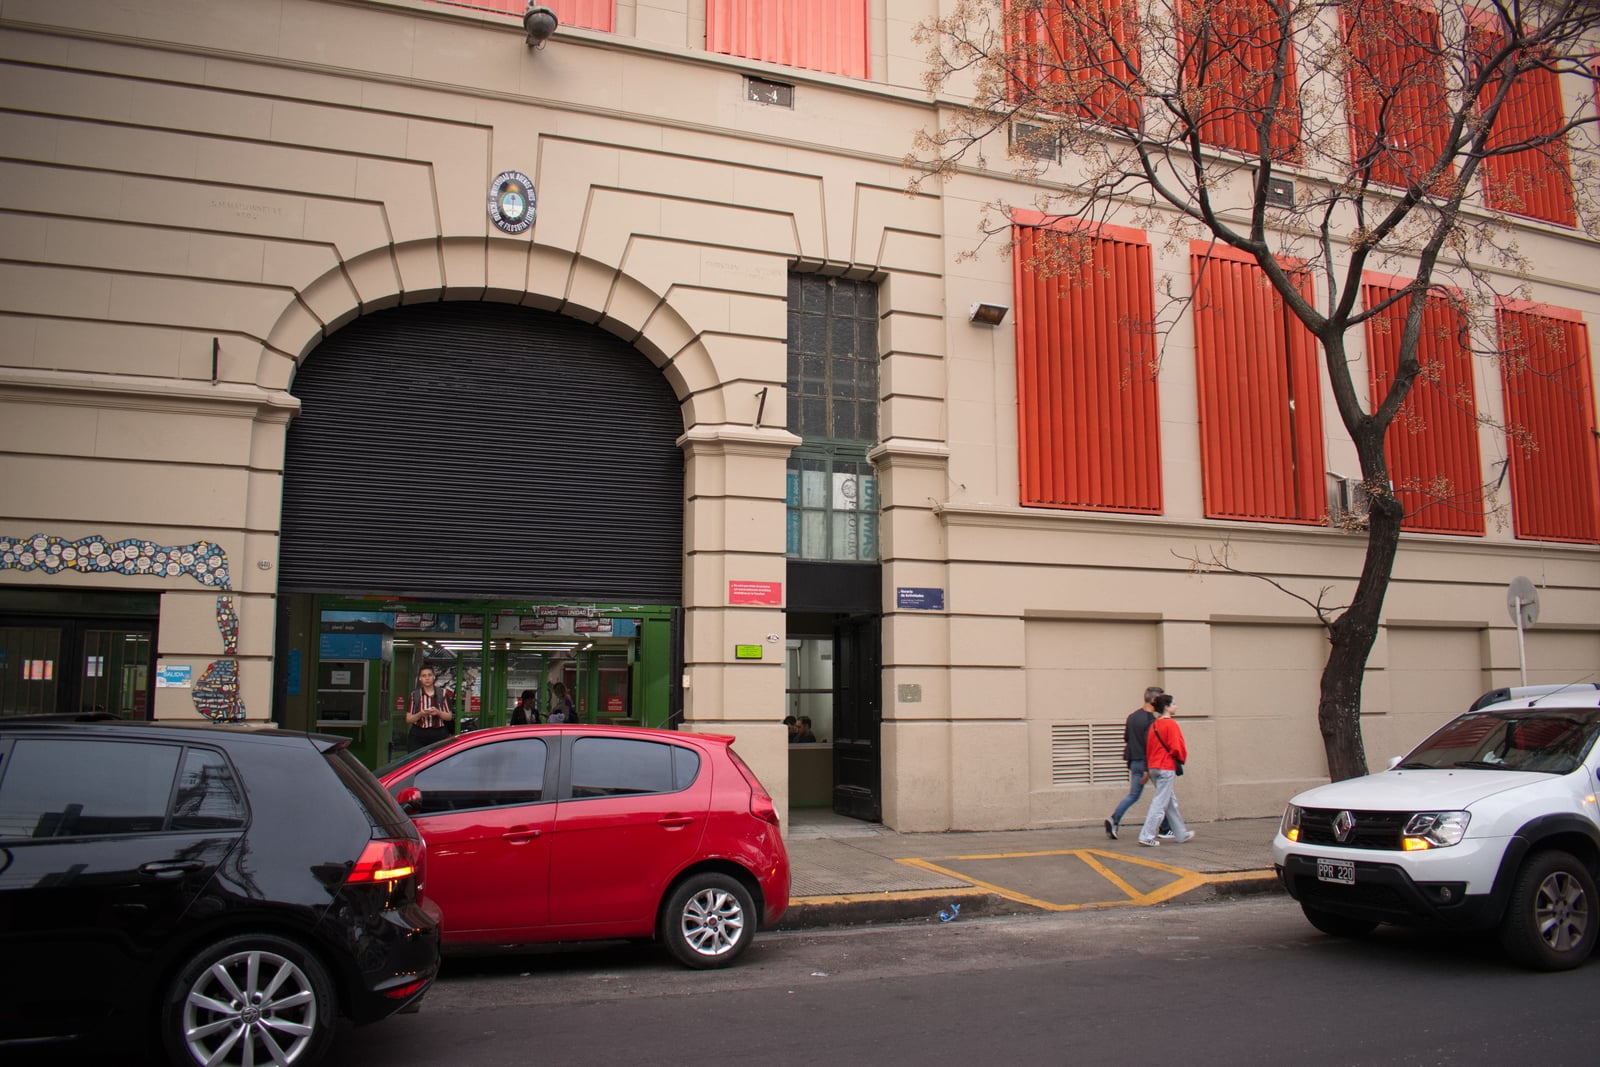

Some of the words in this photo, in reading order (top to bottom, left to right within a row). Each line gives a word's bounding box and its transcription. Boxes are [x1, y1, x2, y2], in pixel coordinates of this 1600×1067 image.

[491, 173, 509, 196] UNIVERSIDAD
[516, 173, 532, 189] BUENOS
[1318, 864, 1334, 878] PPR
[1337, 866, 1353, 880] 220
